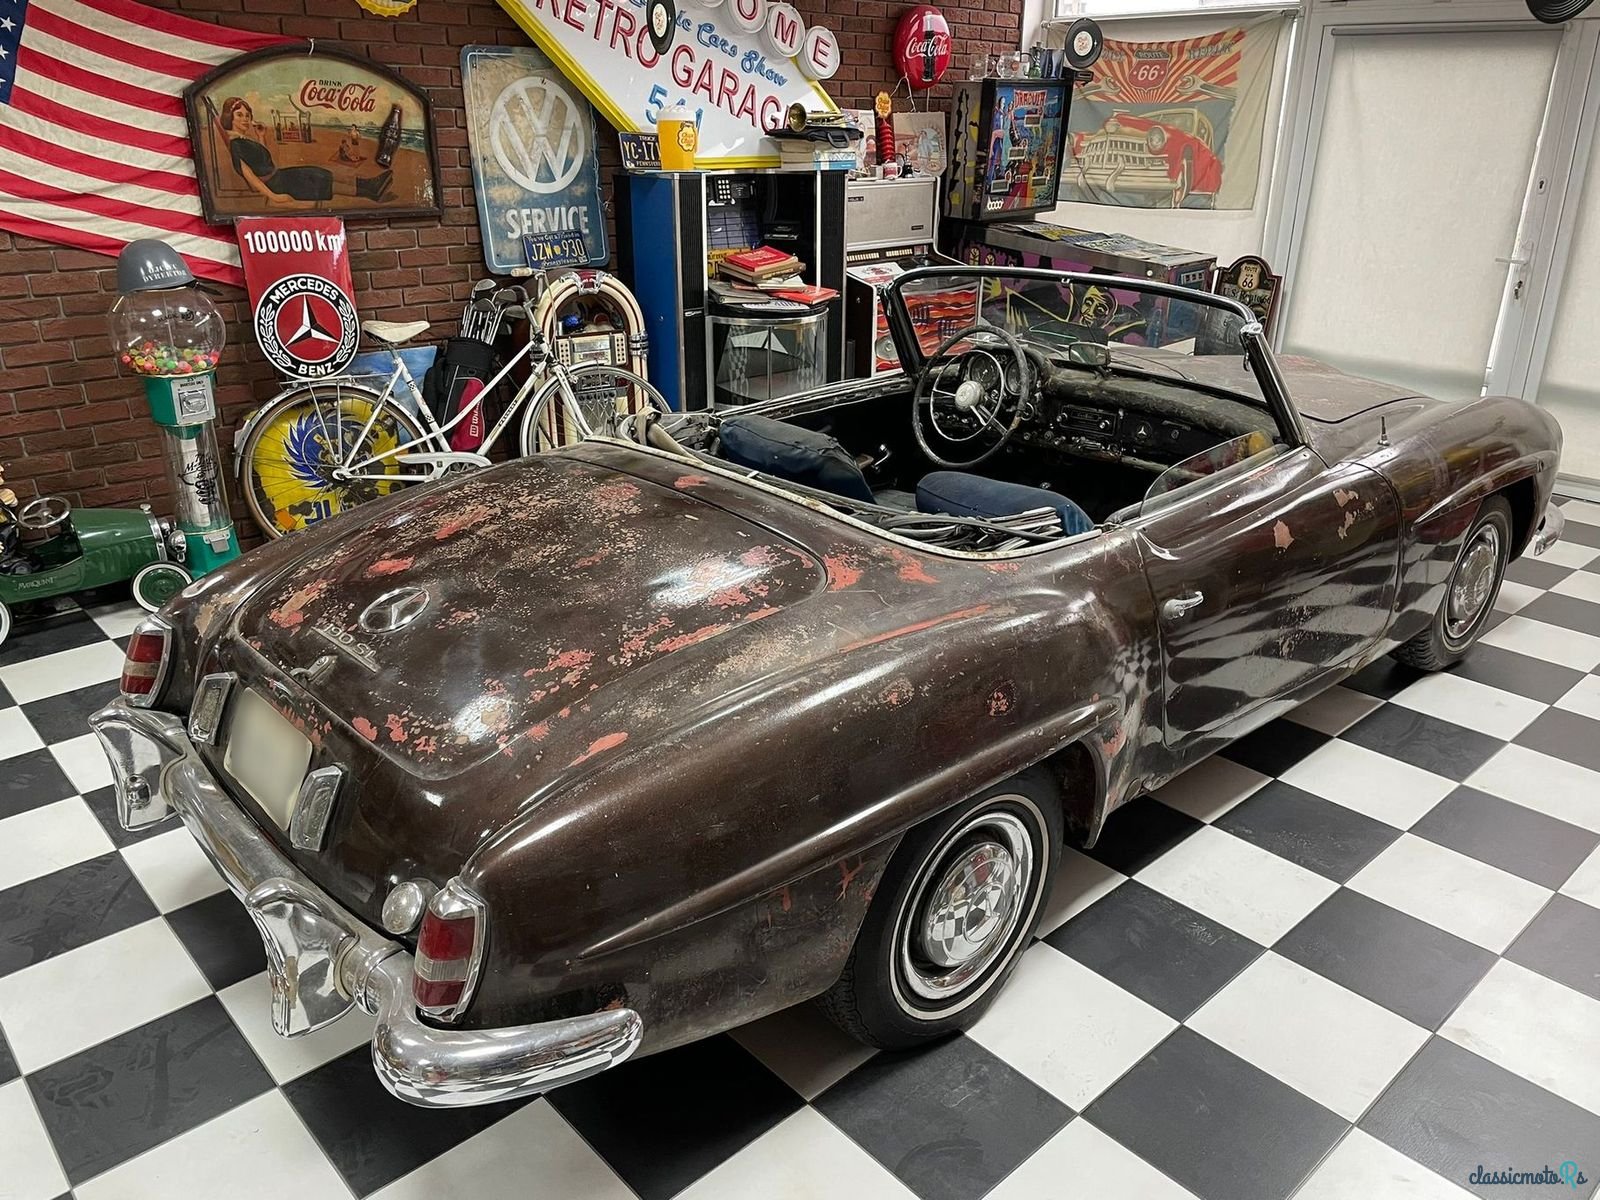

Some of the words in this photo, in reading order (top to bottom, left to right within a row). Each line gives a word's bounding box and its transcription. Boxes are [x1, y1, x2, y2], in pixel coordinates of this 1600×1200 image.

[697, 23, 738, 58] Cars
[741, 50, 788, 87] Show
[319, 79, 342, 87] DRINK
[1137, 65, 1160, 81] 66
[300, 79, 377, 113] Coca-Cola
[671, 44, 791, 132] GARAG
[506, 206, 589, 239] SERVICE
[244, 230, 313, 254] 100000
[315, 230, 343, 252] km
[561, 239, 585, 257] 930
[269, 278, 339, 304] MERCEDES
[1242, 277, 1254, 288] 66
[298, 362, 335, 376] BENZ
[324, 623, 354, 645] 190
[357, 643, 378, 664] SL
